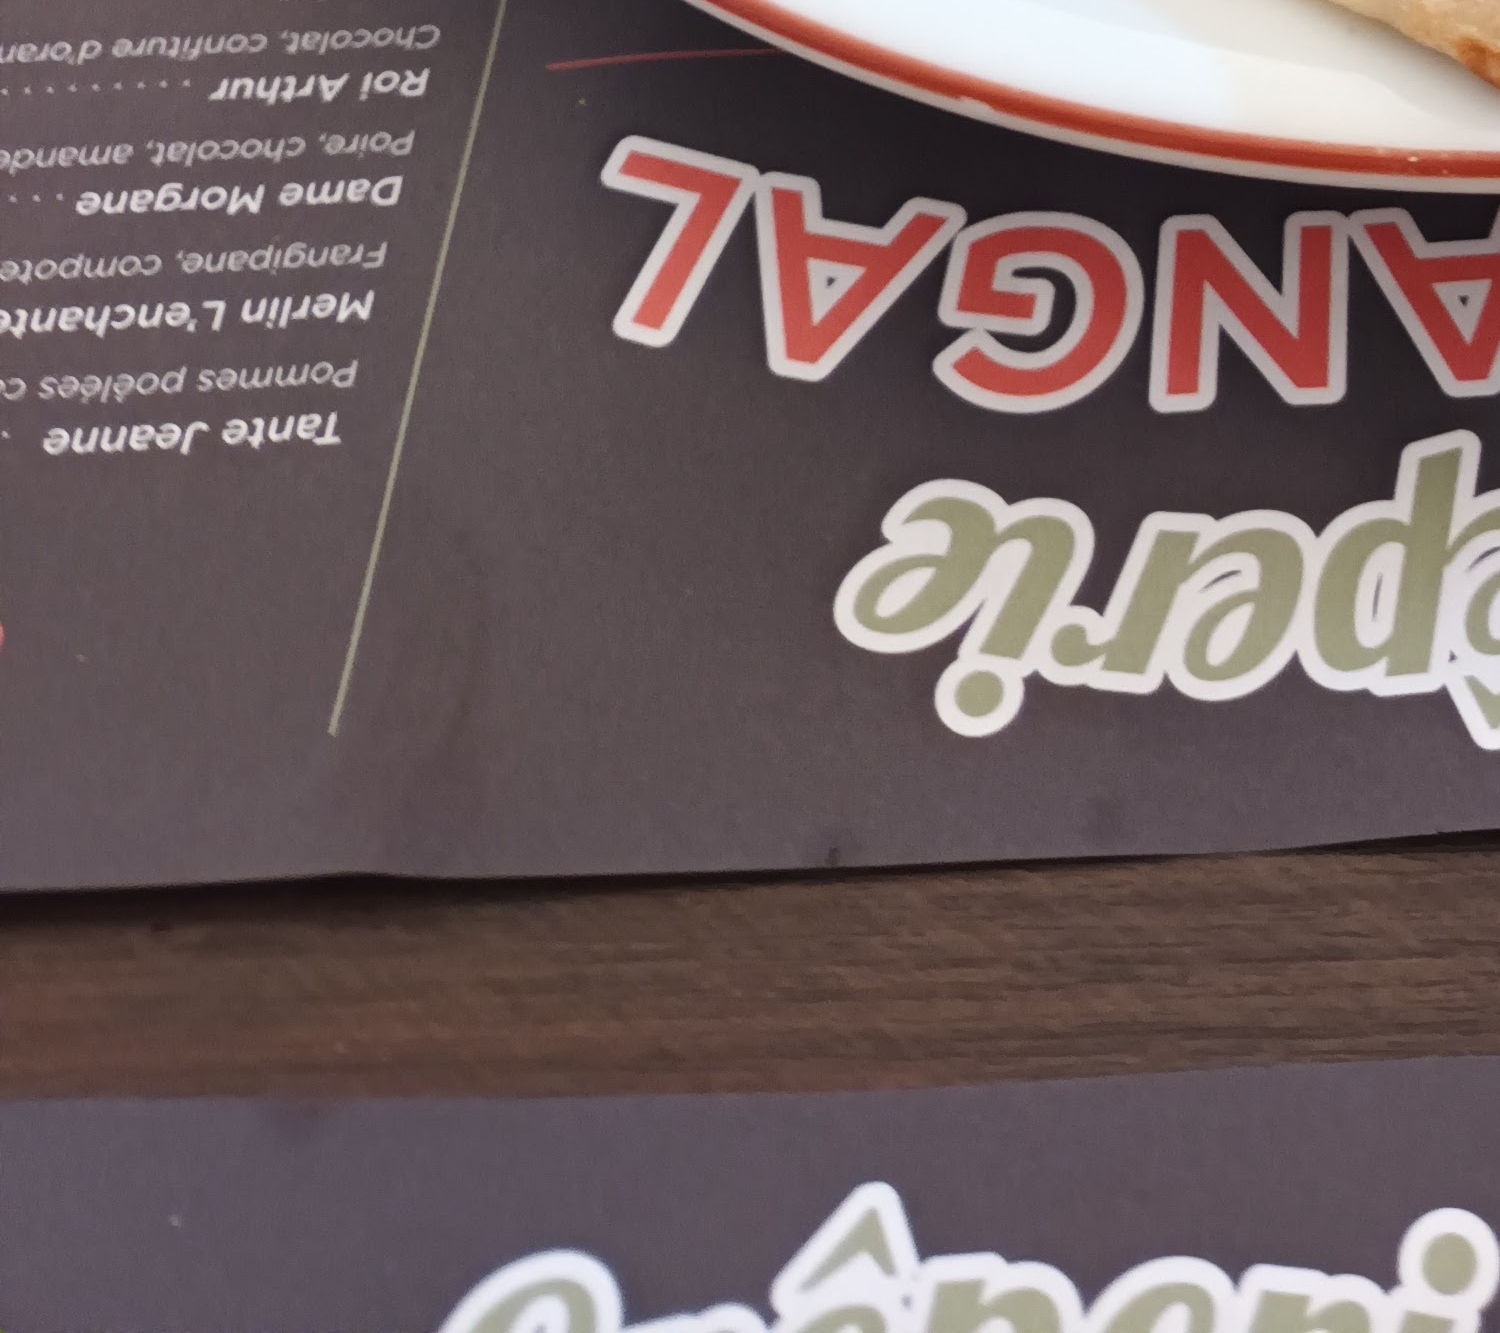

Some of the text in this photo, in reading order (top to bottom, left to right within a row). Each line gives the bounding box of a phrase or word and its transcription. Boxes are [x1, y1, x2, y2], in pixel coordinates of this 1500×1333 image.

[112, 33, 267, 63] confiture
[280, 23, 441, 56] Chocolat,
[209, 67, 430, 104] Roi Arthur
[145, 137, 306, 168] chocolat,
[319, 130, 415, 163] Poire,
[76, 175, 403, 217] Dame Morgane
[176, 239, 388, 276] Frangipane,
[241, 290, 375, 329] Merlin
[39, 366, 188, 404] poêlées
[198, 359, 359, 392] Pommes
[42, 412, 341, 456] Tante Jeanne
